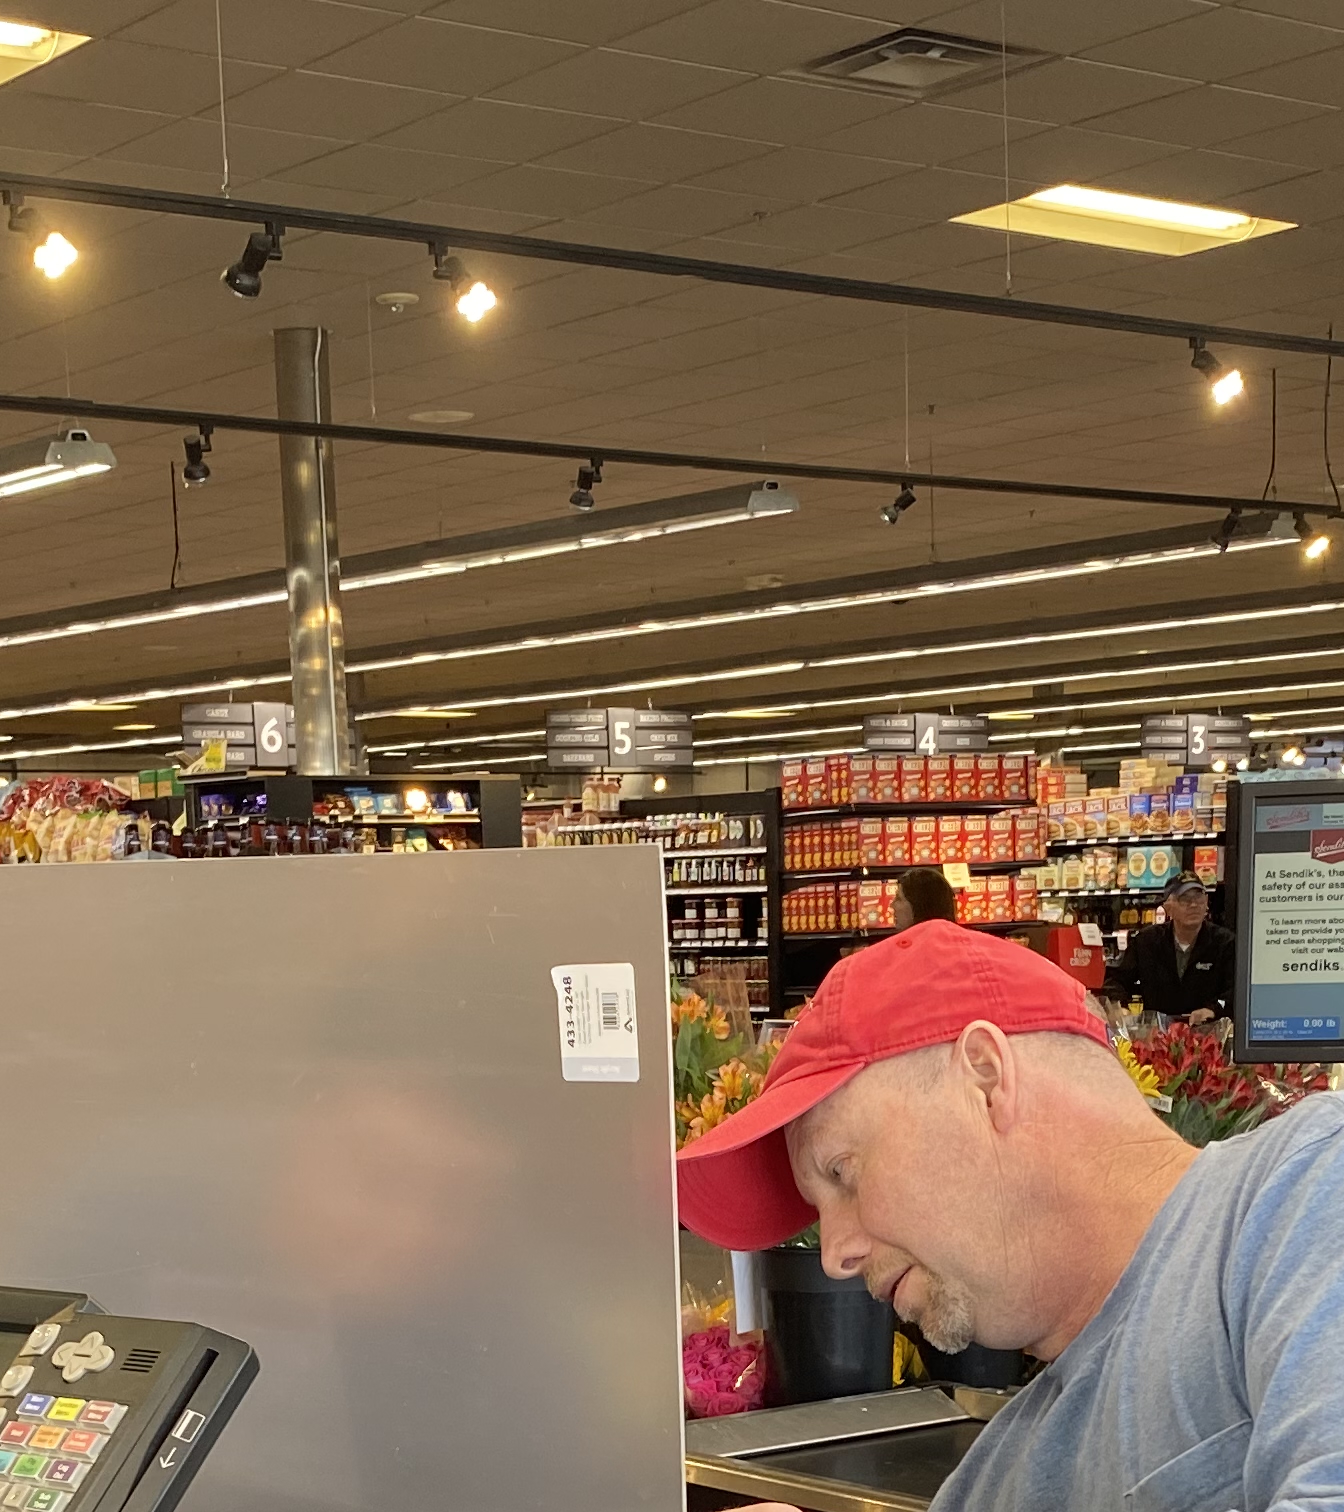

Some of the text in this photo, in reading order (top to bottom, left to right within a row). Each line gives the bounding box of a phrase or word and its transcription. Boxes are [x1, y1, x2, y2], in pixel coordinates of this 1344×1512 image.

[260, 717, 283, 753] 6
[614, 721, 632, 755] 5
[919, 726, 936, 755] 4
[1191, 725, 1205, 754] 3
[1265, 870, 1276, 879] At
[1279, 869, 1325, 879] Sendik's,
[1328, 868, 1344, 877] the
[1262, 882, 1293, 893] safety
[1296, 881, 1306, 890] of
[1308, 882, 1326, 890] our
[1259, 895, 1313, 903] customers
[1315, 894, 1324, 902] is
[1270, 918, 1280, 926] To
[1266, 928, 1289, 936] taken
[1301, 927, 1333, 936] provide
[563, 976, 576, 1048] 433-4248
[1252, 1019, 1336, 1029] Weight: 0.00 lb
